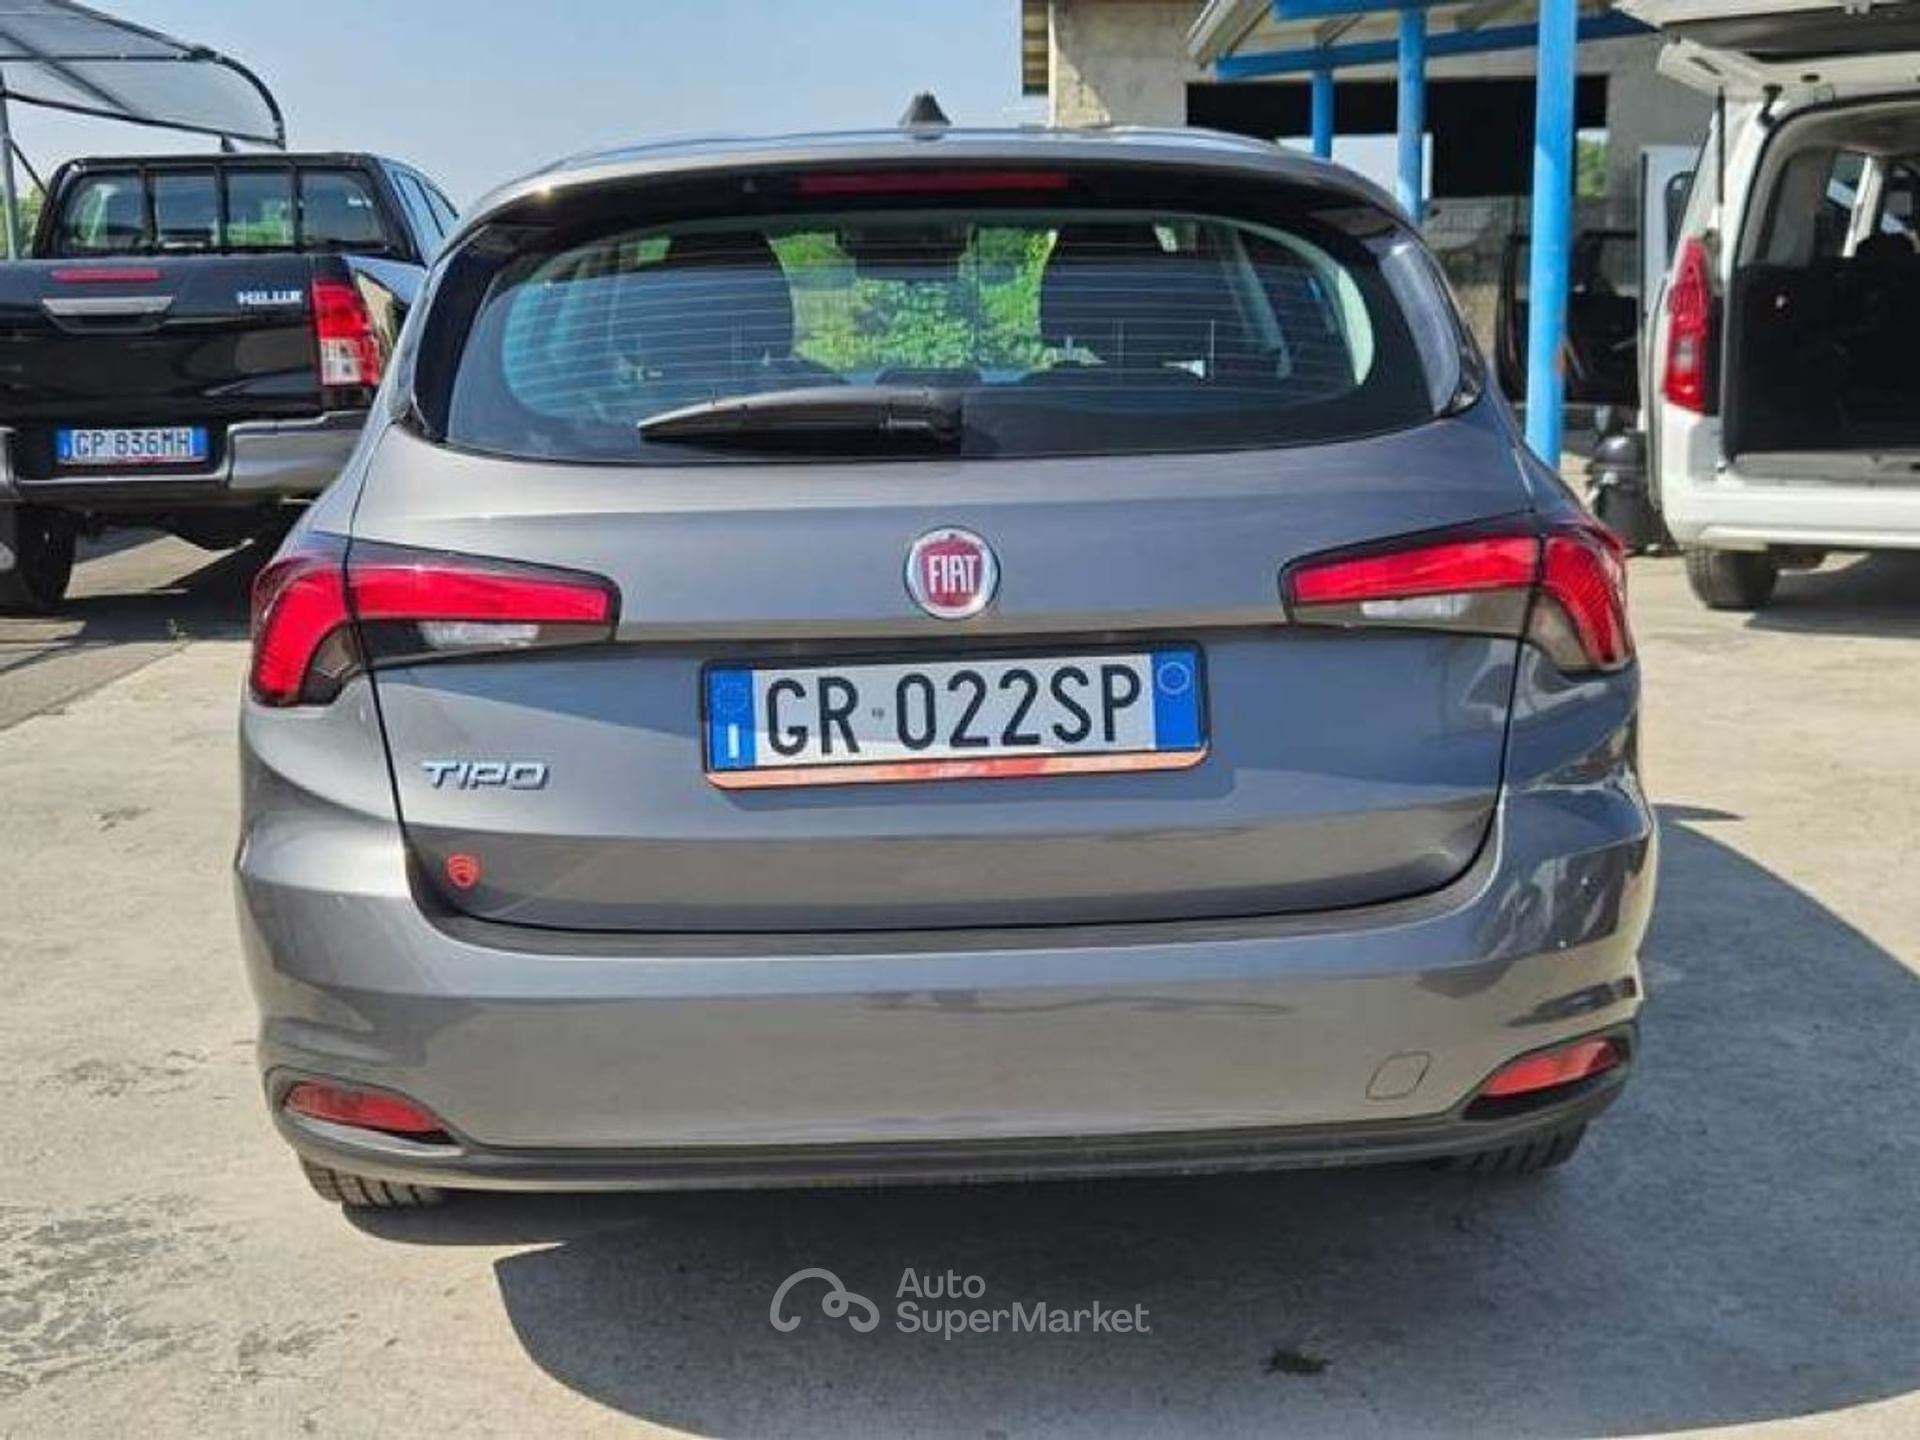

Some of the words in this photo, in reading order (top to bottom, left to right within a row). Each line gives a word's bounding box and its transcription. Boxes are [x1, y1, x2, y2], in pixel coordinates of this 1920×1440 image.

[114, 430, 191, 456] 836MH
[928, 554, 979, 594] FIAT
[766, 676, 861, 756] GR
[896, 663, 1142, 751] 022SP
[421, 760, 549, 790] TIPO
